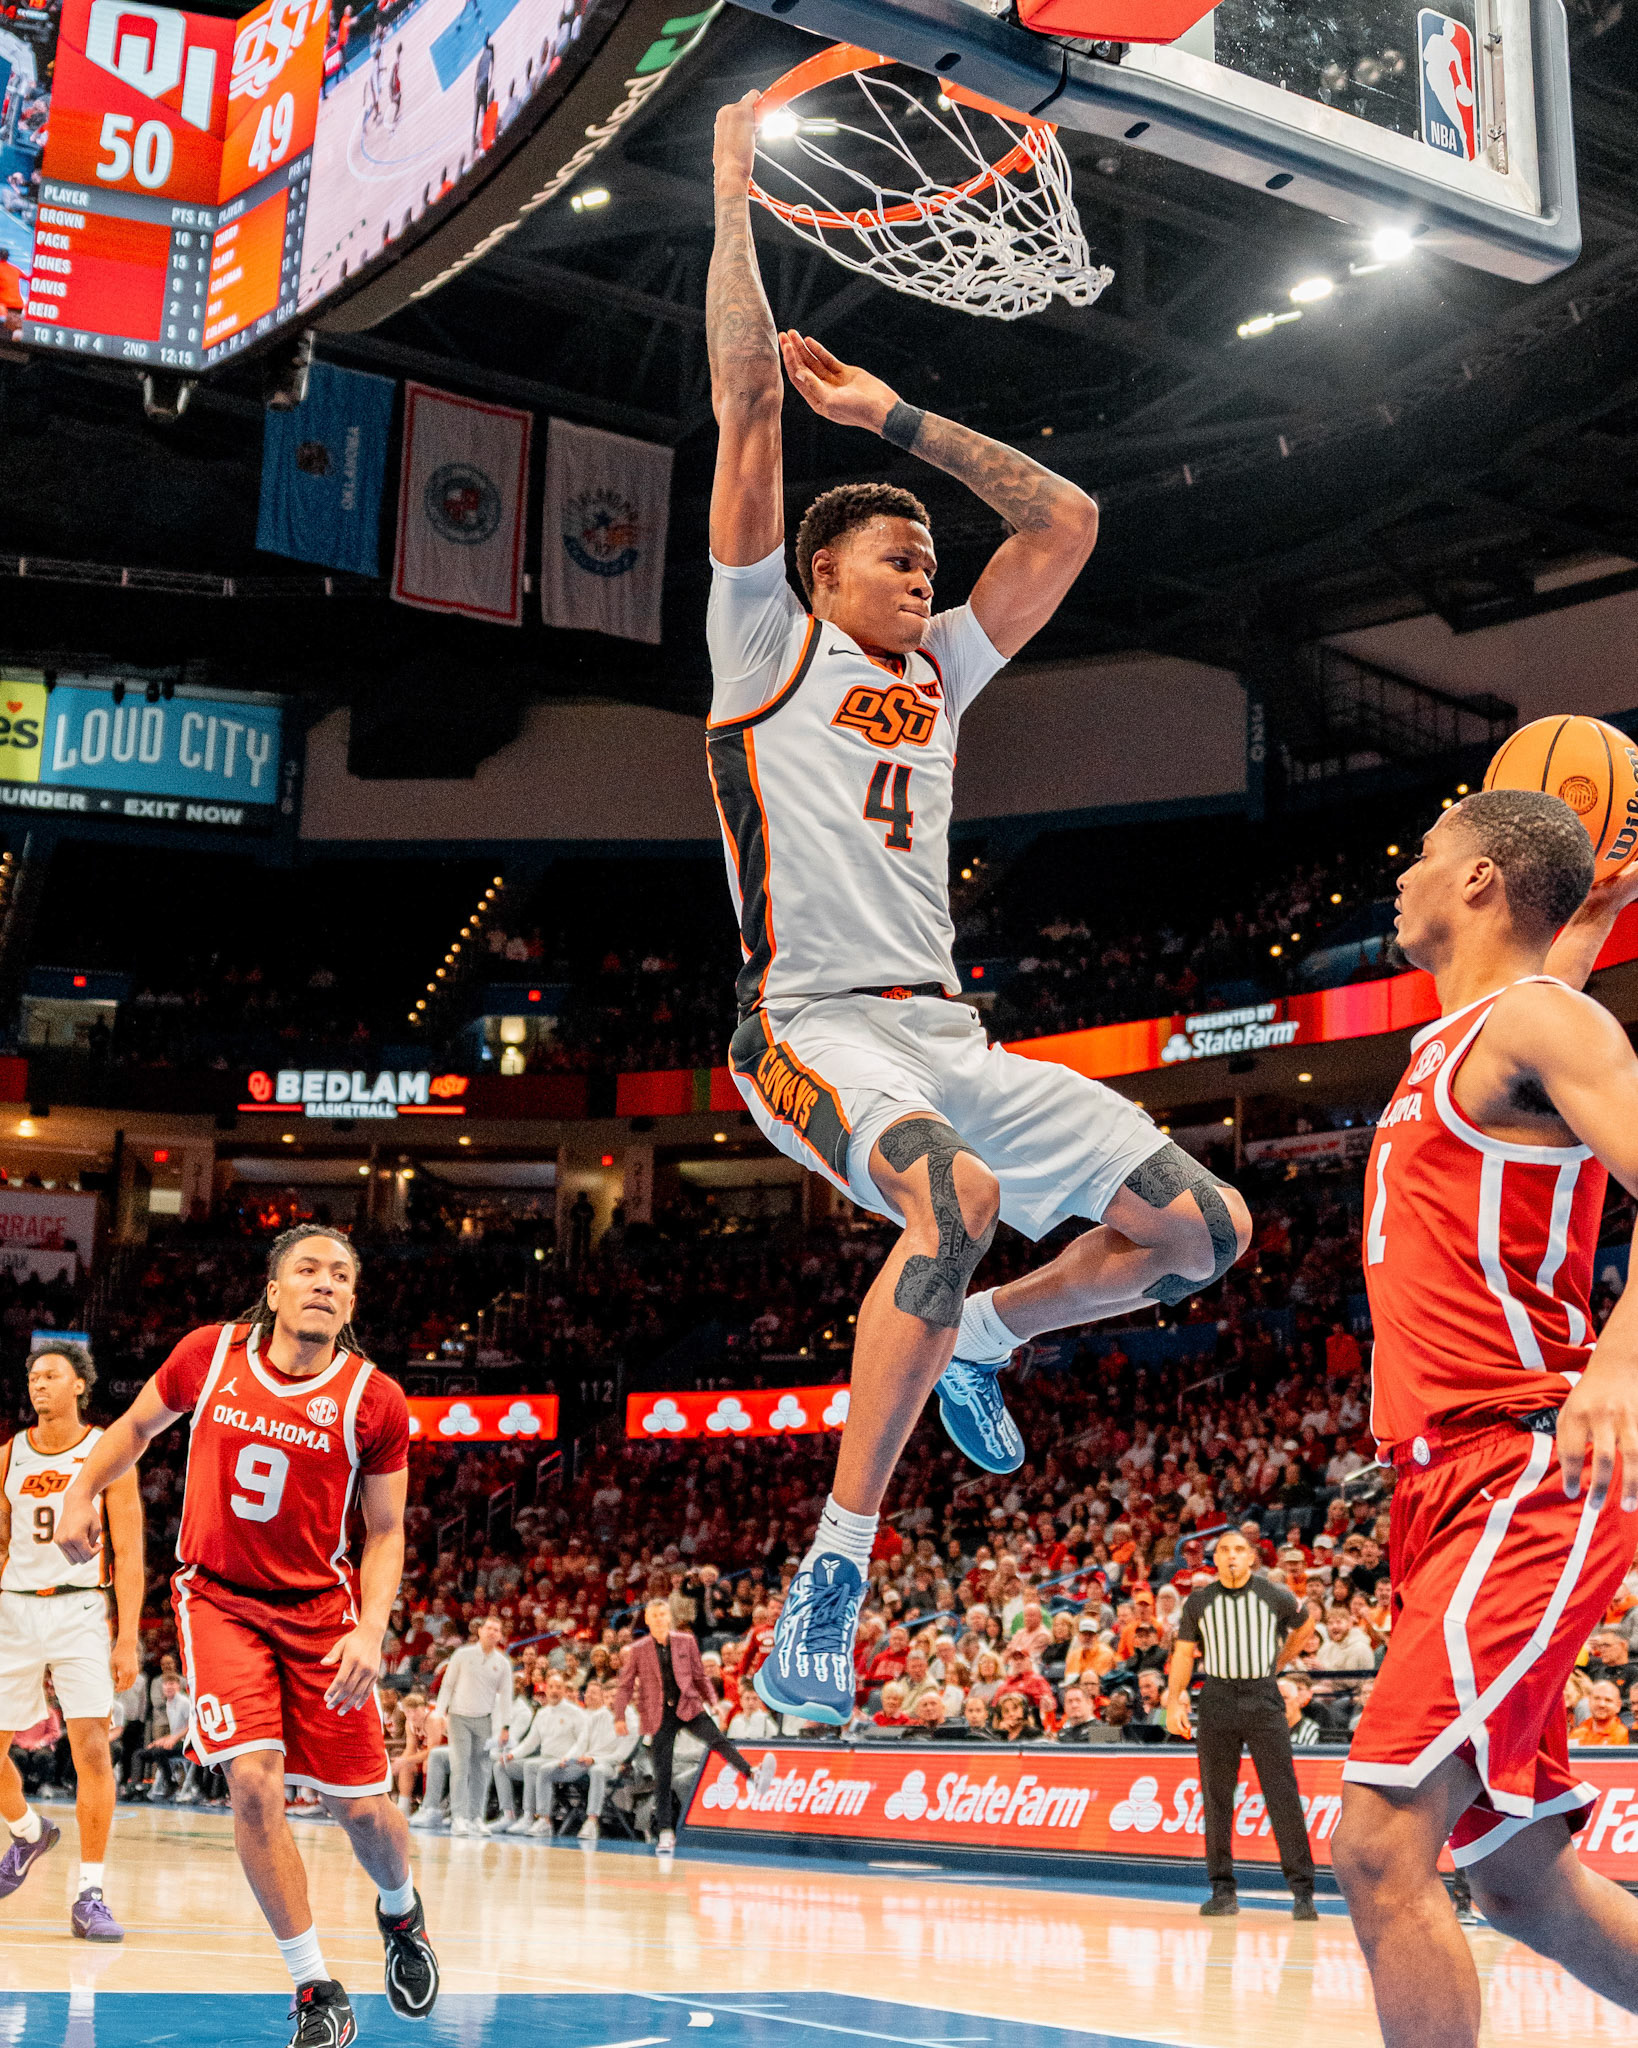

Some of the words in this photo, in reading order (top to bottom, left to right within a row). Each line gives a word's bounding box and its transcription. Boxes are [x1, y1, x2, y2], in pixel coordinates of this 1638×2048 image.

[96, 113, 173, 189] 50
[249, 92, 294, 172] 49
[1431, 120, 1457, 152] NBA
[44, 185, 90, 207] PLAYER
[172, 208, 194, 225] PTS
[198, 211, 213, 228] FL
[218, 199, 246, 225] PLAYER
[39, 208, 85, 230] BROWN
[175, 231, 192, 247] 10
[200, 234, 208, 250] 1
[36, 231, 70, 250] PACK
[172, 254, 189, 270] 15
[197, 257, 206, 272] 1
[33, 254, 71, 275] JONES
[172, 277, 184, 294] 9
[195, 281, 203, 296] 1
[30, 277, 67, 297] DAVIS
[169, 301, 181, 317] 2
[192, 304, 200, 319] 1
[28, 300, 59, 320] REID
[188, 327, 197, 342] 0
[34, 326, 51, 343] TO
[56, 330, 65, 345] 3
[73, 333, 90, 348] TF
[93, 336, 104, 351] 4
[123, 341, 149, 357] 2ND
[160, 347, 195, 365] 12:15
[830, 683, 940, 749] OSU
[53, 707, 164, 771] LOUD
[179, 711, 270, 787] CITY
[0, 787, 87, 811] UNDER
[124, 799, 180, 820] EXIT
[186, 804, 243, 825] NOW
[863, 760, 914, 852] 4
[1186, 1007, 1256, 1033] PRESENTED
[1256, 1003, 1276, 1022] BY
[276, 1070, 430, 1104] BEDLAM
[306, 1103, 398, 1118] BASKETBALL
[1367, 1141, 1392, 1266] 1
[213, 1404, 331, 1453] OKLAHOMA
[309, 1397, 338, 1426] SEC
[19, 1470, 72, 1499] OSU
[230, 1443, 290, 1523] 9
[33, 1506, 55, 1544] 9
[196, 1693, 237, 1742] OU
